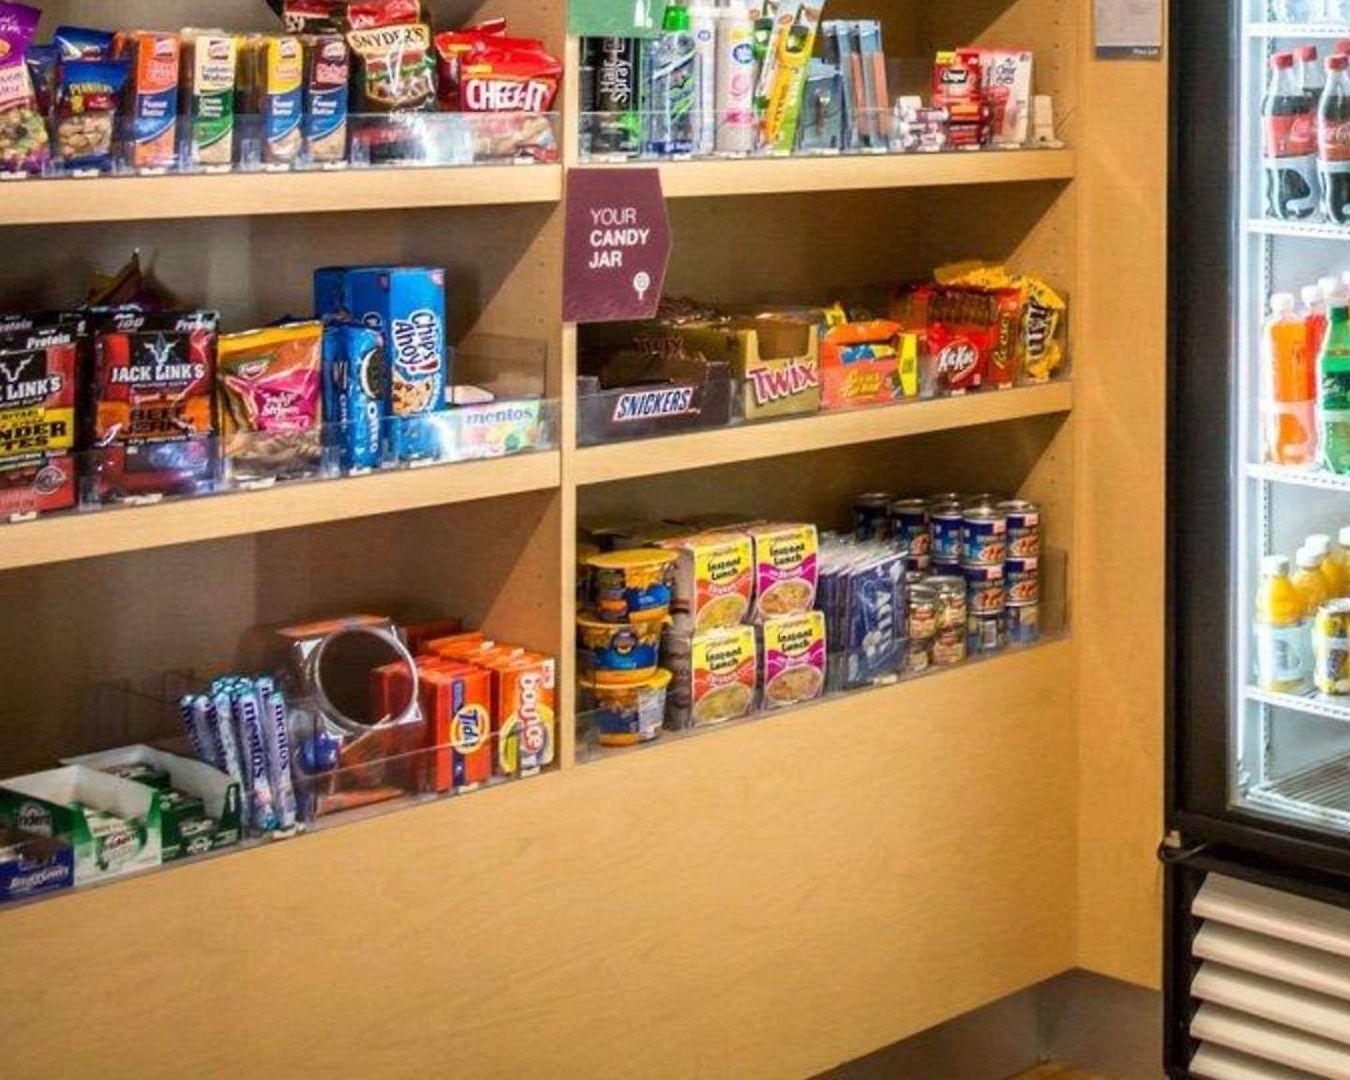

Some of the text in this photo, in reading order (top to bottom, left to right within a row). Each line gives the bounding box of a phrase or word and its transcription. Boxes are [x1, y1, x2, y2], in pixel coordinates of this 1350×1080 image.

[351, 27, 425, 48] SNYDER'S
[590, 207, 637, 225] YOUR
[589, 228, 650, 247] CANDY
[588, 250, 623, 269] JAR
[411, 310, 437, 361] Chips
[112, 366, 151, 383] JACK
[616, 389, 690, 417] SNICKERS
[467, 406, 533, 424] mentos
[459, 708, 479, 747] Tide
